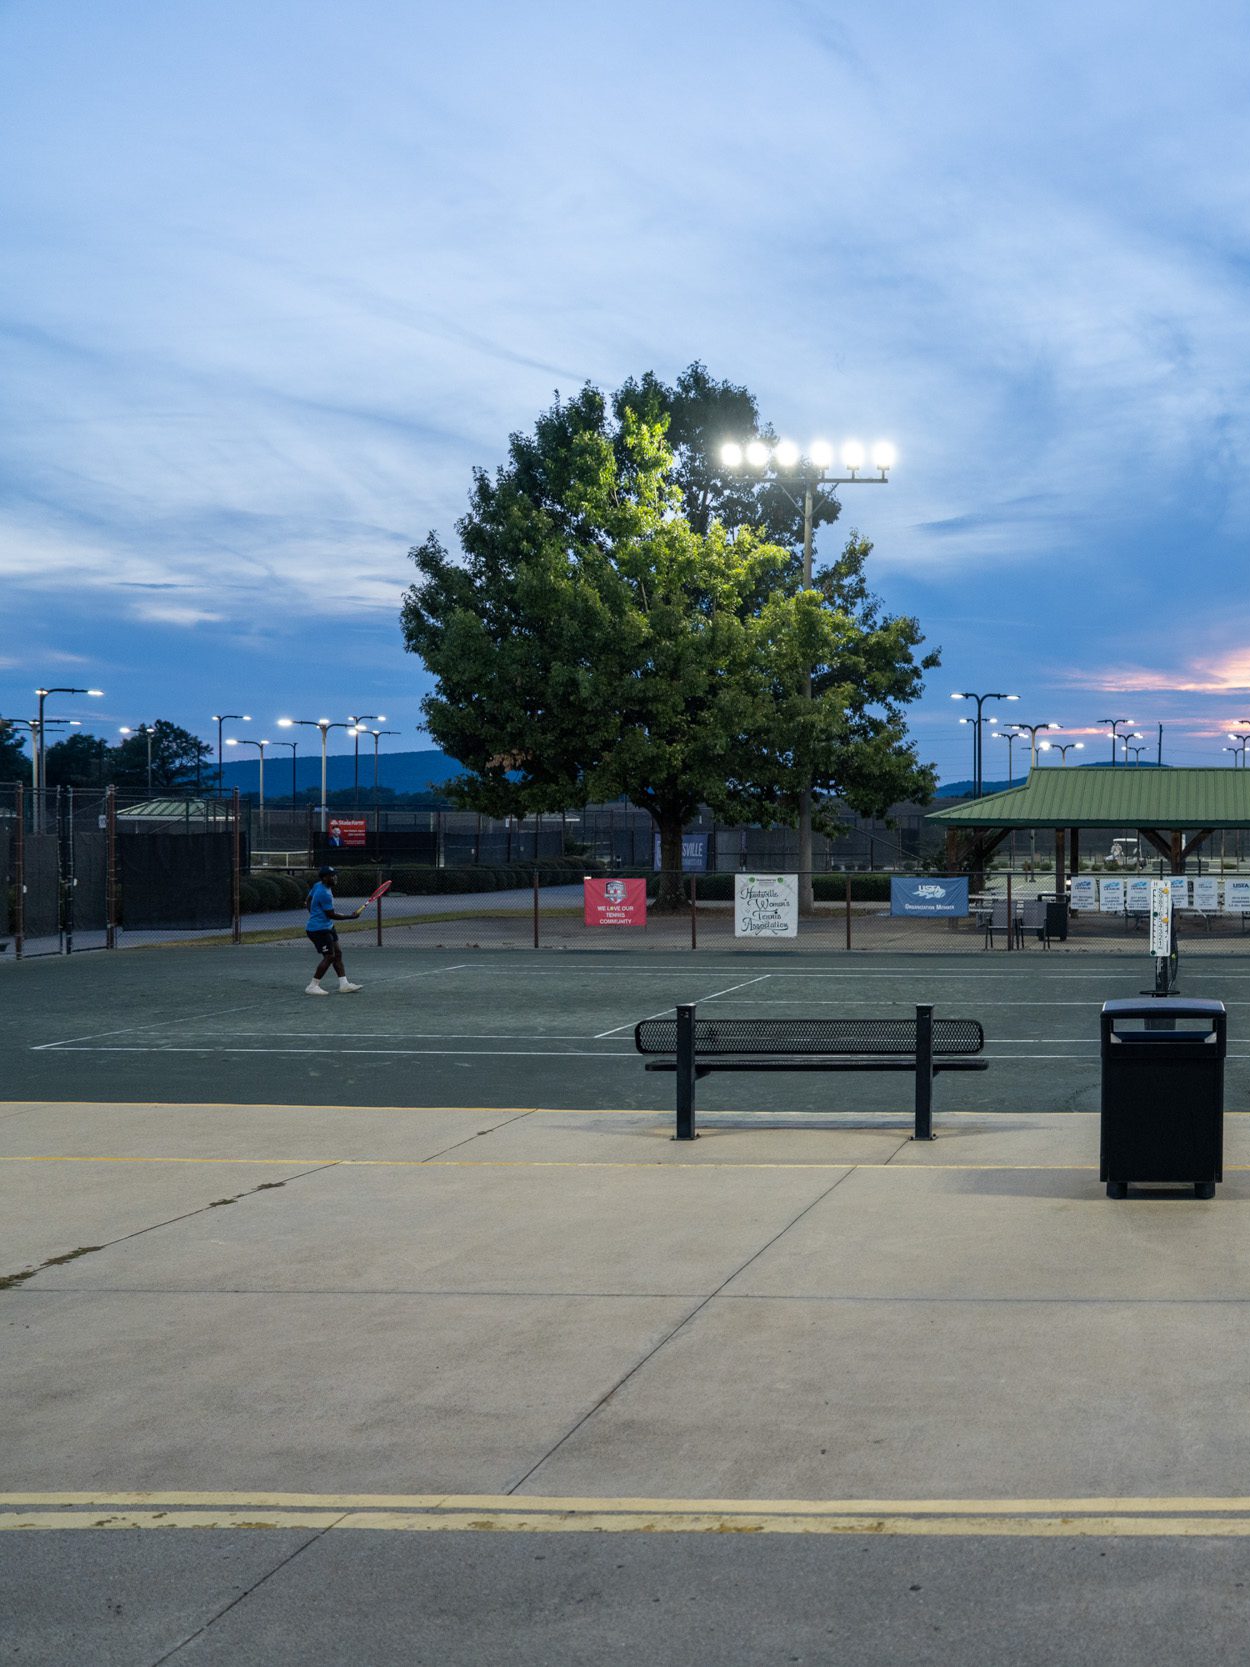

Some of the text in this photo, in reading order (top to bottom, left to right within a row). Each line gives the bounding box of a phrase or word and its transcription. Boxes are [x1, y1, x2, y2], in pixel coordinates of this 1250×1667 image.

[682, 842, 703, 857] SVILLE
[740, 885, 779, 899] Huntsville
[752, 909, 782, 920] Tennis
[741, 917, 789, 932] Association
